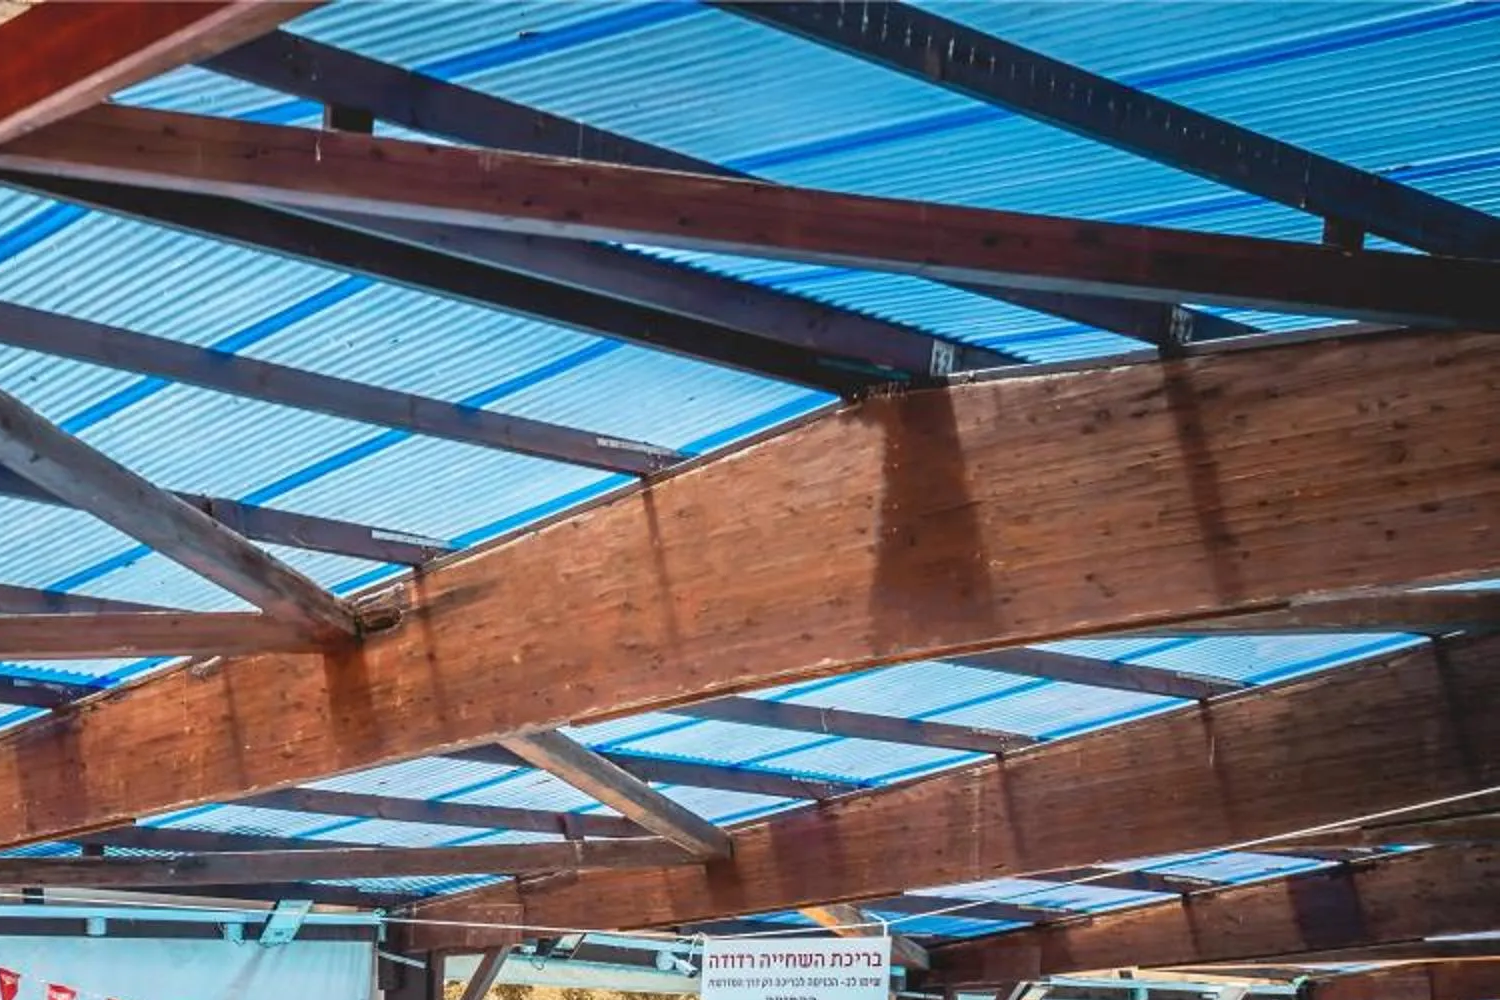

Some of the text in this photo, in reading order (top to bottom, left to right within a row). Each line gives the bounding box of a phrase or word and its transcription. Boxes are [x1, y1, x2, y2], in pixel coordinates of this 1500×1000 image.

[708, 952, 883, 969] בריכת השחייה רדודה
